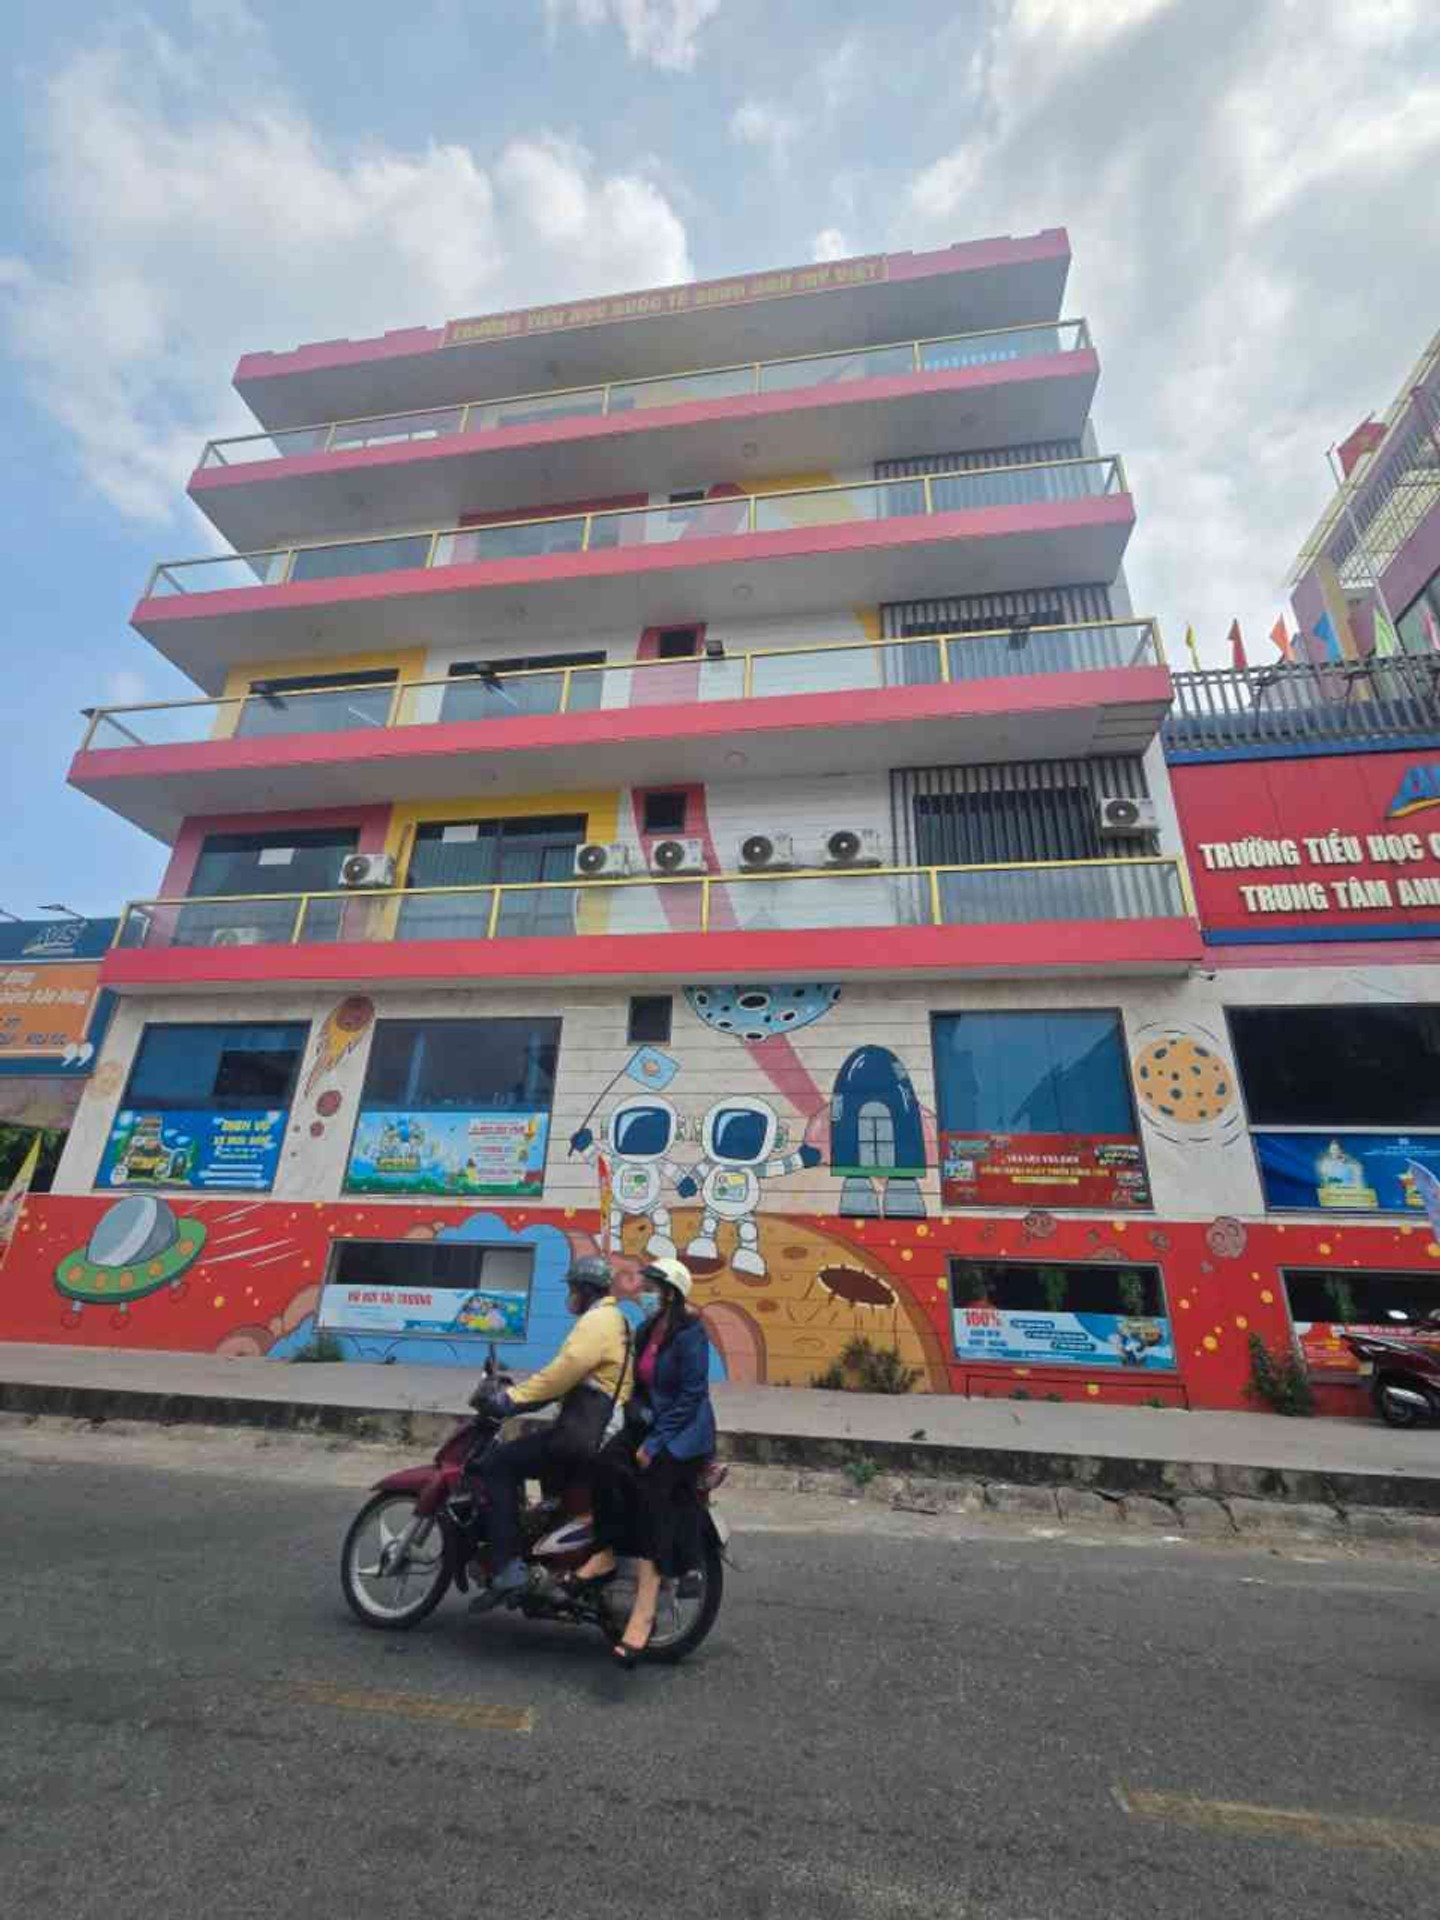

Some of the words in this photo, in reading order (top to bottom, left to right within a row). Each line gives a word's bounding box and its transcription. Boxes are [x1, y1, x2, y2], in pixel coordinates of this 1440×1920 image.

[1198, 835, 1300, 870] TRƯỜNG
[1303, 828, 1363, 864] TIỂU
[1367, 833, 1424, 865] HỌC
[1240, 882, 1329, 912] TRUNG
[1331, 876, 1393, 909] TÂM
